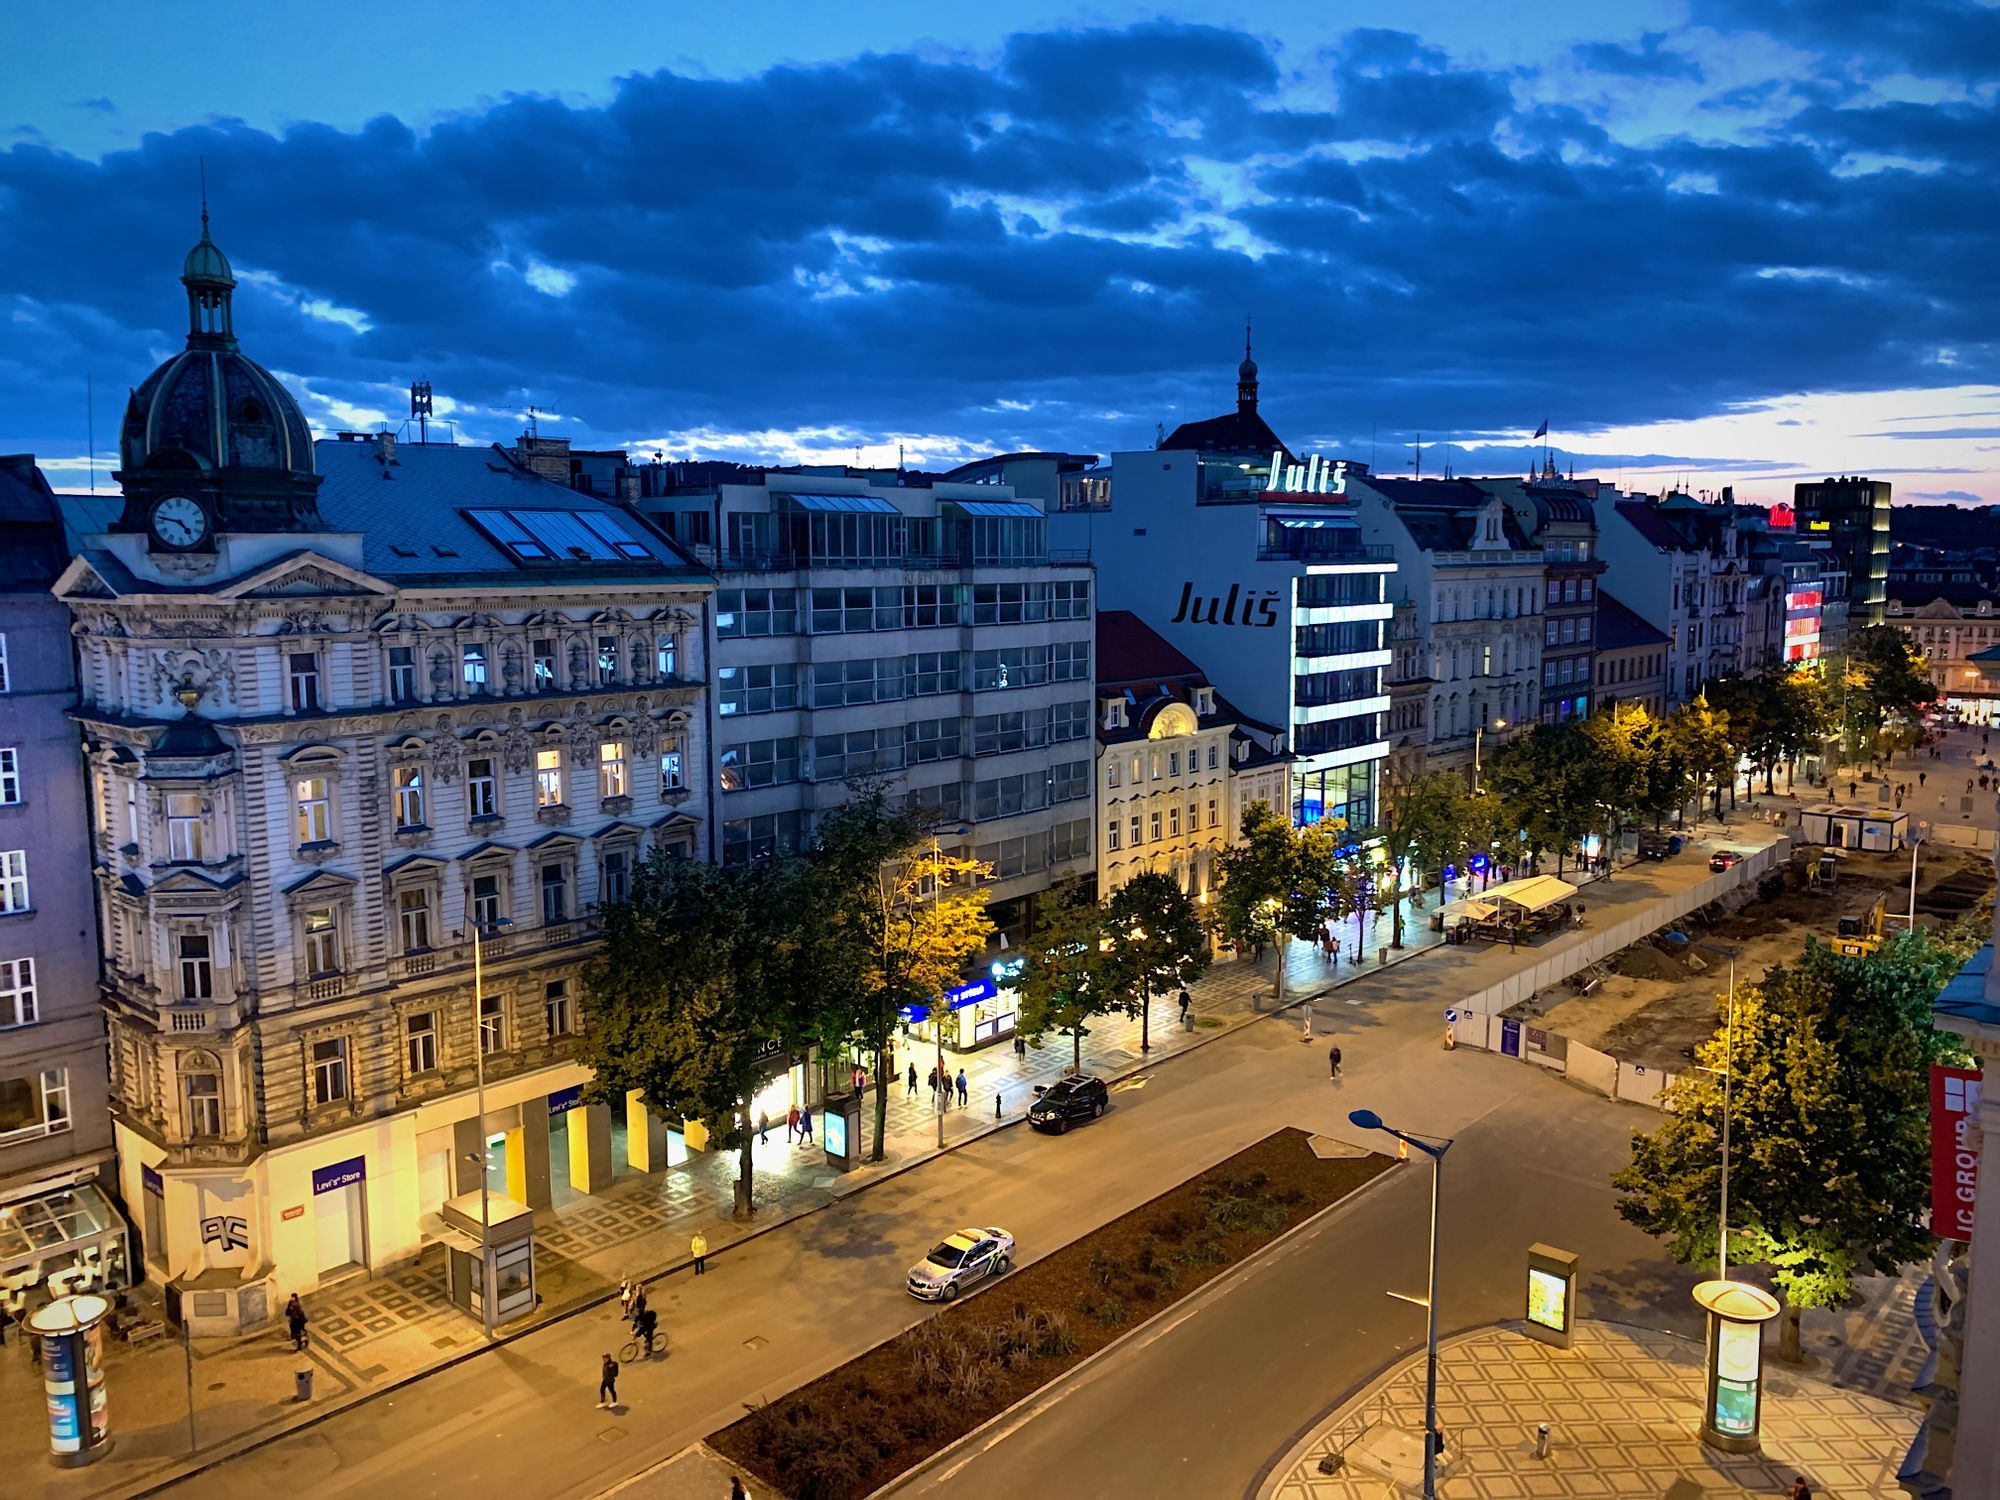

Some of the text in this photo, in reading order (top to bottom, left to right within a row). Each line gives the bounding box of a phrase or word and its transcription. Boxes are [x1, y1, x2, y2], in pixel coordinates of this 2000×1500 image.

[1266, 451, 1346, 494] Juliš
[1171, 582, 1280, 627] Juliš
[1845, 945, 1859, 955] CAT
[341, 1171, 361, 1183] Store
